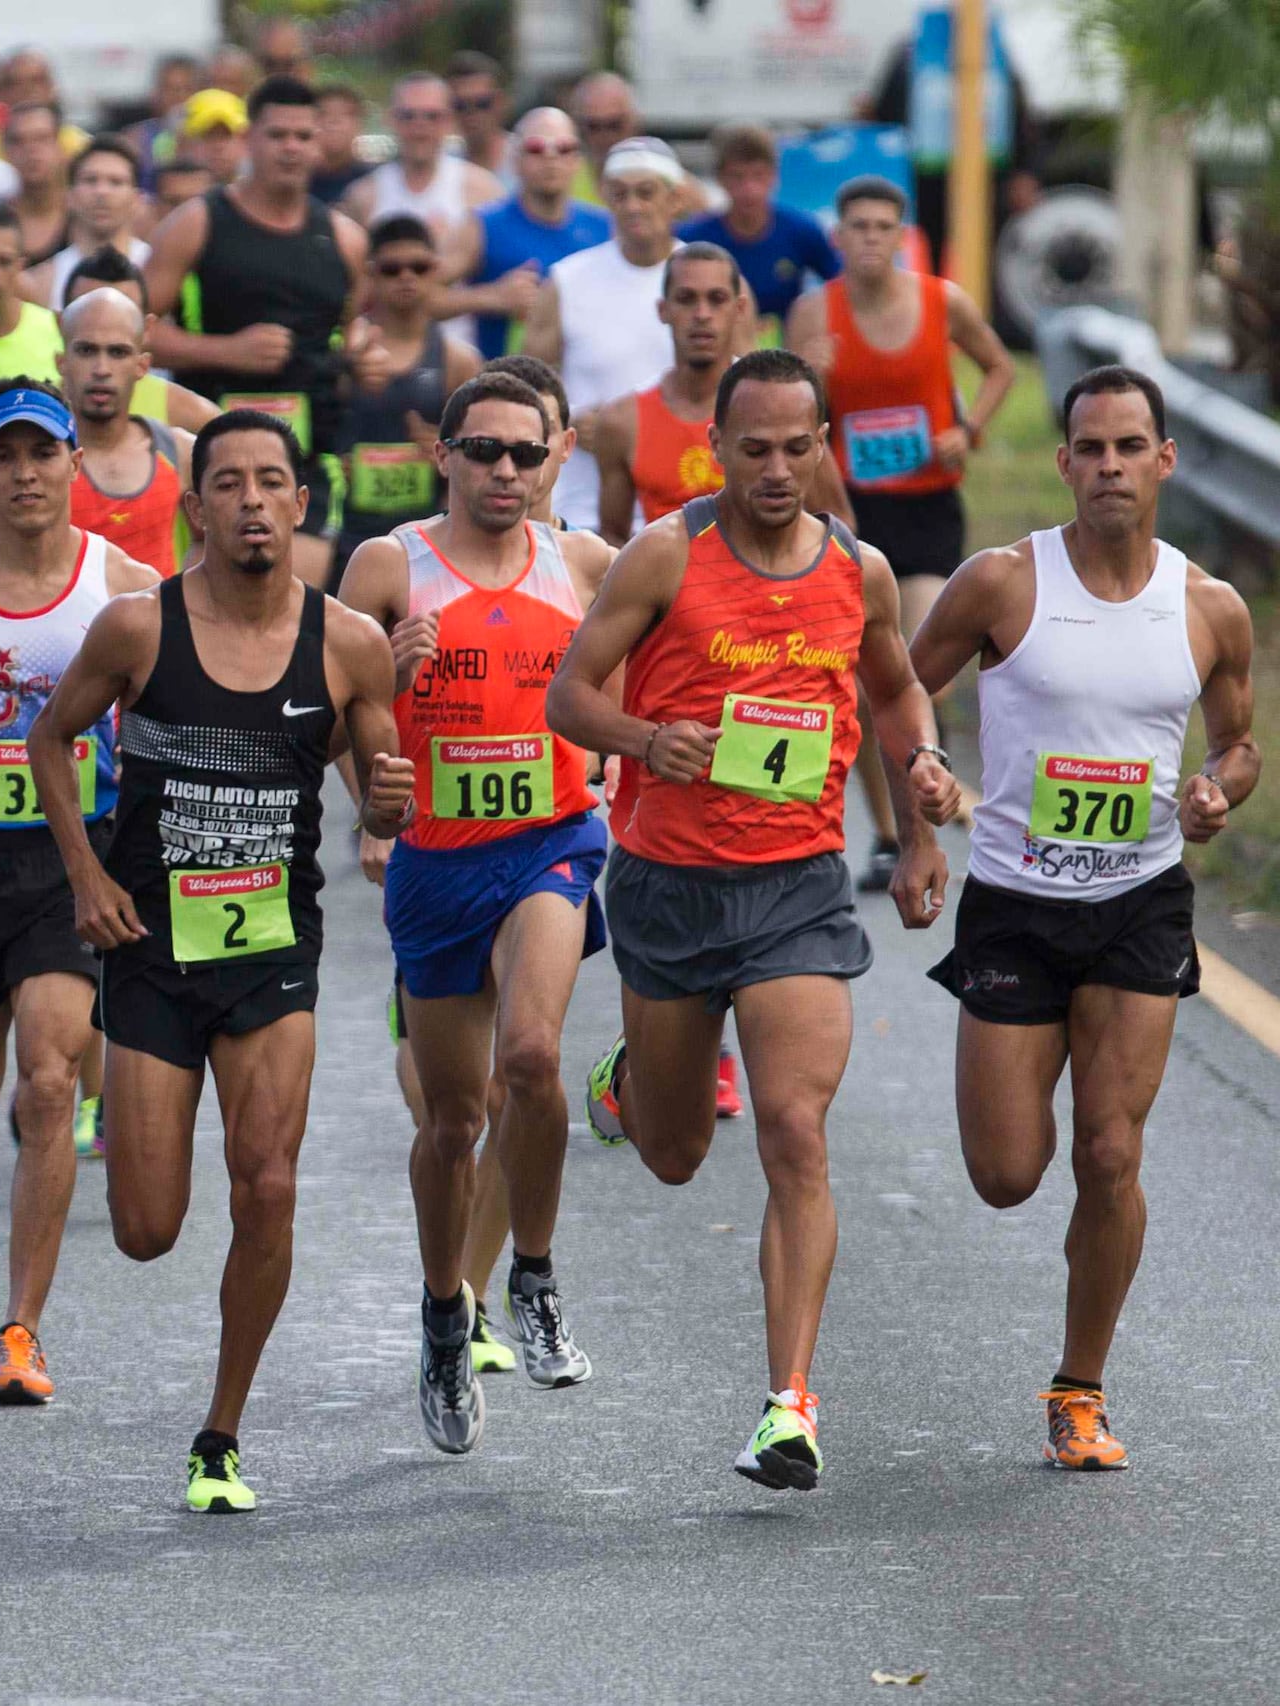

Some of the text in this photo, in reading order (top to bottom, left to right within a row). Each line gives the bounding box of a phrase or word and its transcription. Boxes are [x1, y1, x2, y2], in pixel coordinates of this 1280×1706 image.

[709, 630, 779, 672] Olympic
[743, 704, 822, 728] Walgreens 5K
[447, 742, 536, 760] Walgreens 5K
[763, 739, 789, 784] 4
[1054, 761, 1142, 781] Walgreens 5K
[163, 779, 299, 806] FLICHI AUTO PARTS
[457, 771, 533, 818] 196
[174, 801, 289, 821] ISABELA-AGUADA
[1053, 788, 1135, 837] 370
[161, 843, 193, 863] 787
[187, 871, 274, 892] Walgreens 5K
[222, 902, 248, 949] 2
